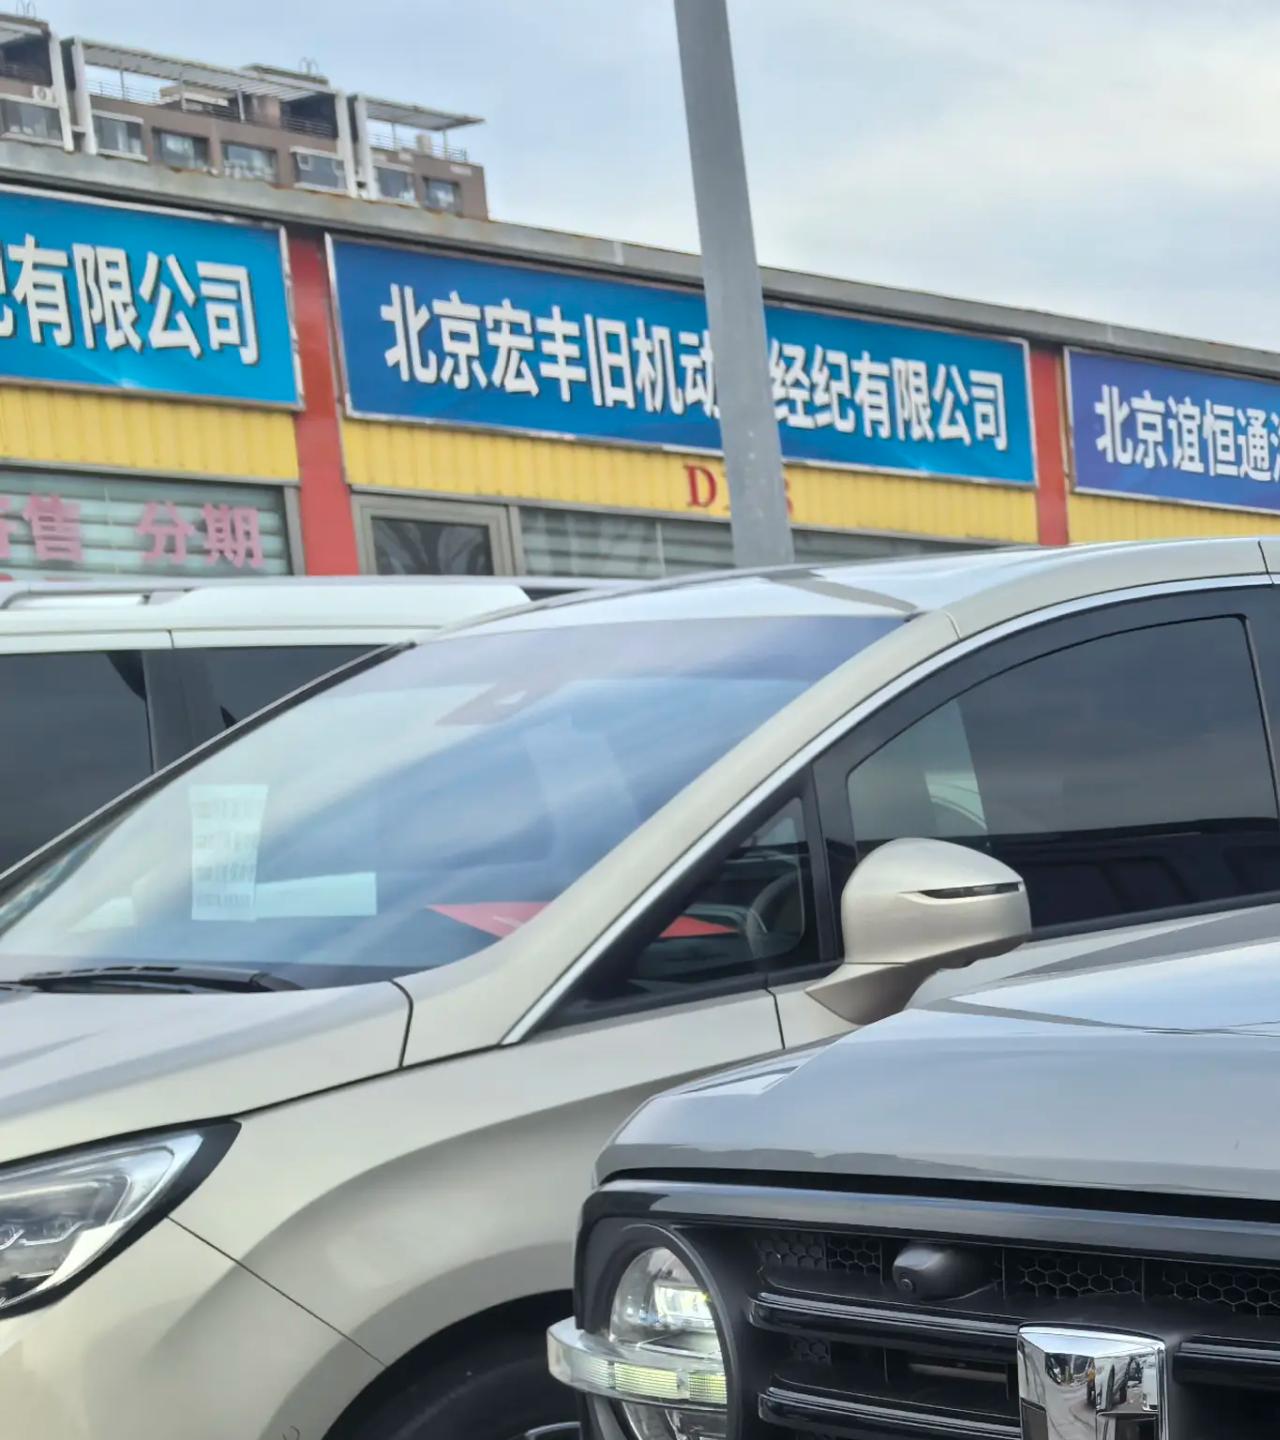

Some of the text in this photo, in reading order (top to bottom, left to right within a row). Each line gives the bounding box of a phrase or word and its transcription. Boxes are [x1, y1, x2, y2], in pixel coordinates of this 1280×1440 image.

[0, 233, 258, 365] 有限公司
[380, 284, 1008, 451] 北京宏丰旧机动经纪有限公司
[136, 501, 264, 568] 分期
